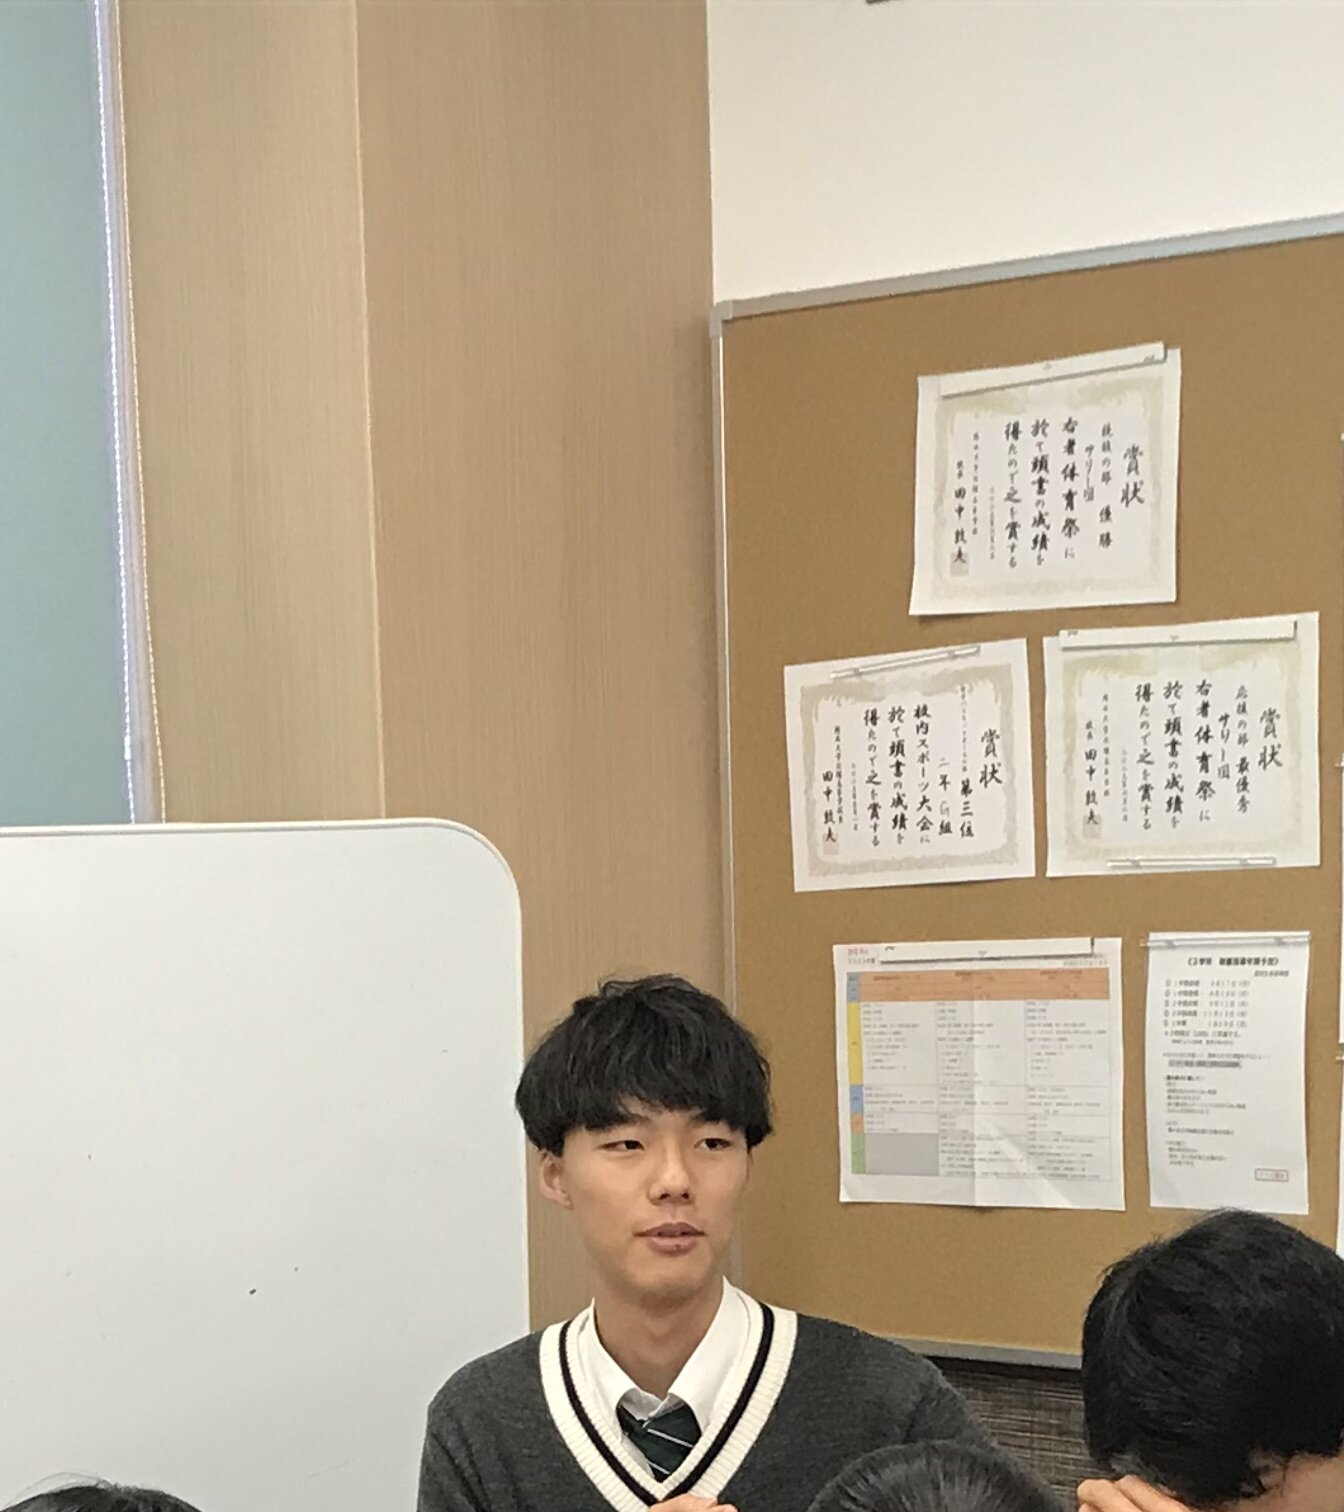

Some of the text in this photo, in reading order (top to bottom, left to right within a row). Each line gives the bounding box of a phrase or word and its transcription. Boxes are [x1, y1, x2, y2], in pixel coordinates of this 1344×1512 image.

[1121, 444, 1144, 508] 賞状
[979, 728, 1002, 789] 賞状
[1258, 708, 1282, 771] 賞状
[914, 704, 933, 843] 校内スポーツ大会に
[960, 778, 974, 838] 第三位
